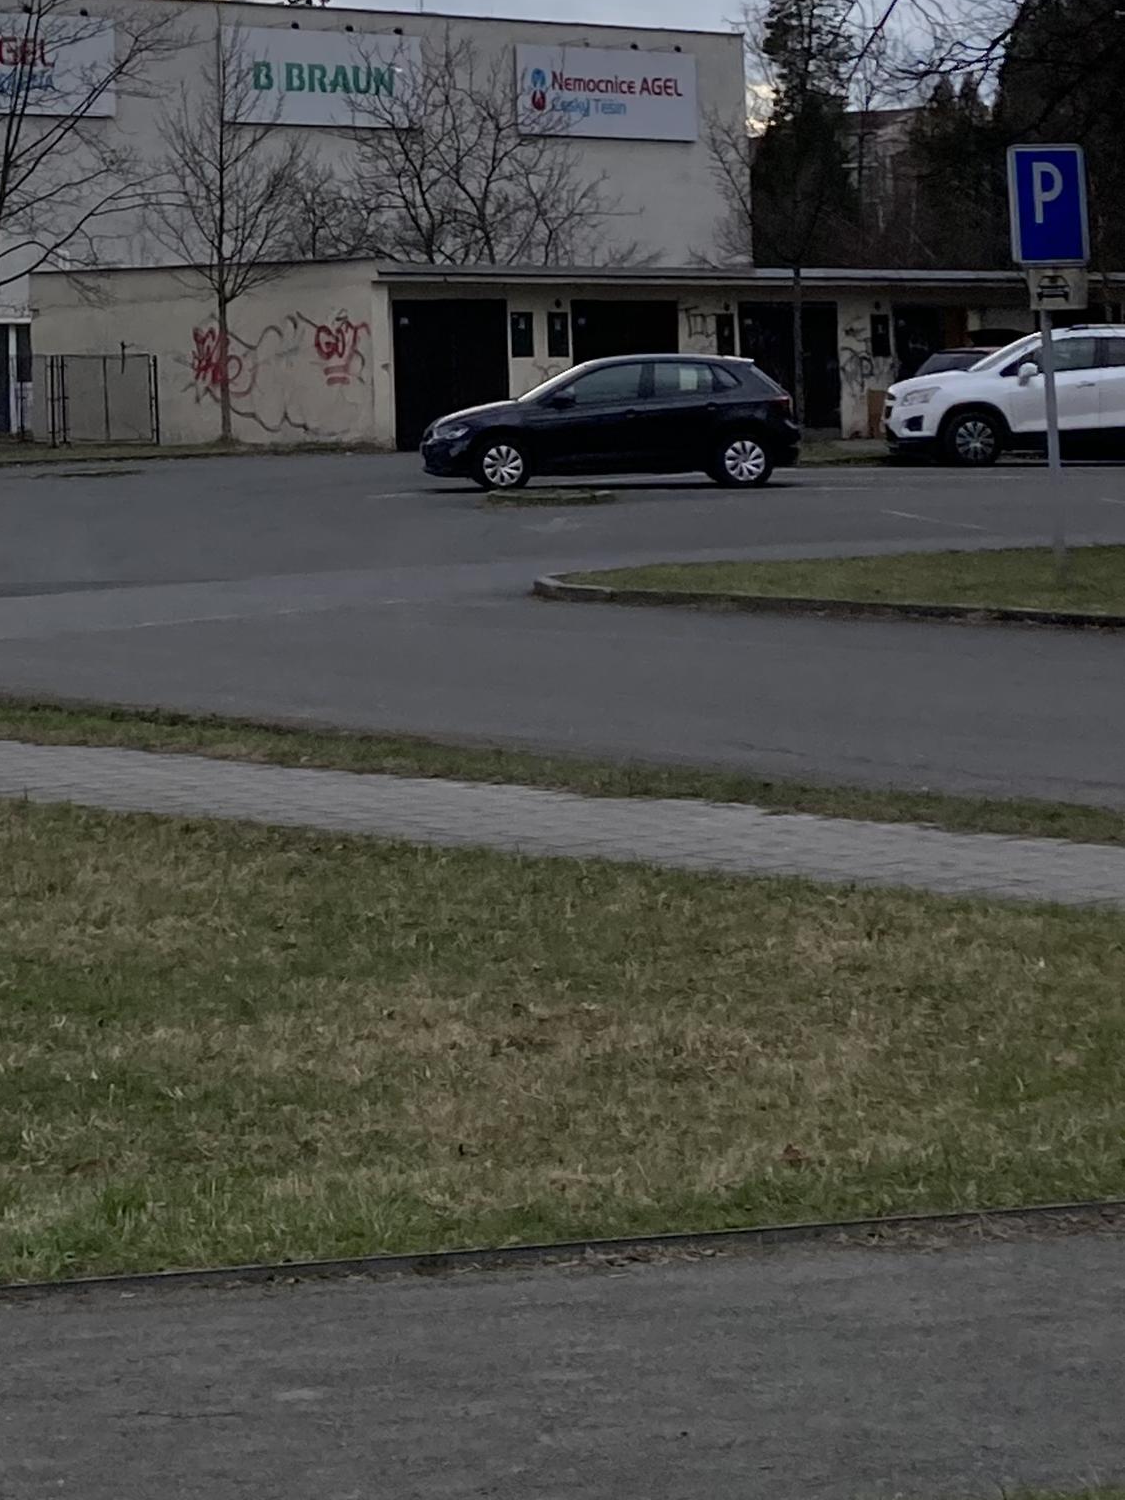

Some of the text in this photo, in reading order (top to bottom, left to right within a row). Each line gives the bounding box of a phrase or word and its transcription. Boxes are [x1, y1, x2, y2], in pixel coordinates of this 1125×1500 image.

[285, 62, 394, 96] BRAUN
[551, 71, 683, 97] Nemocnice AGEL
[1032, 161, 1063, 224] P
